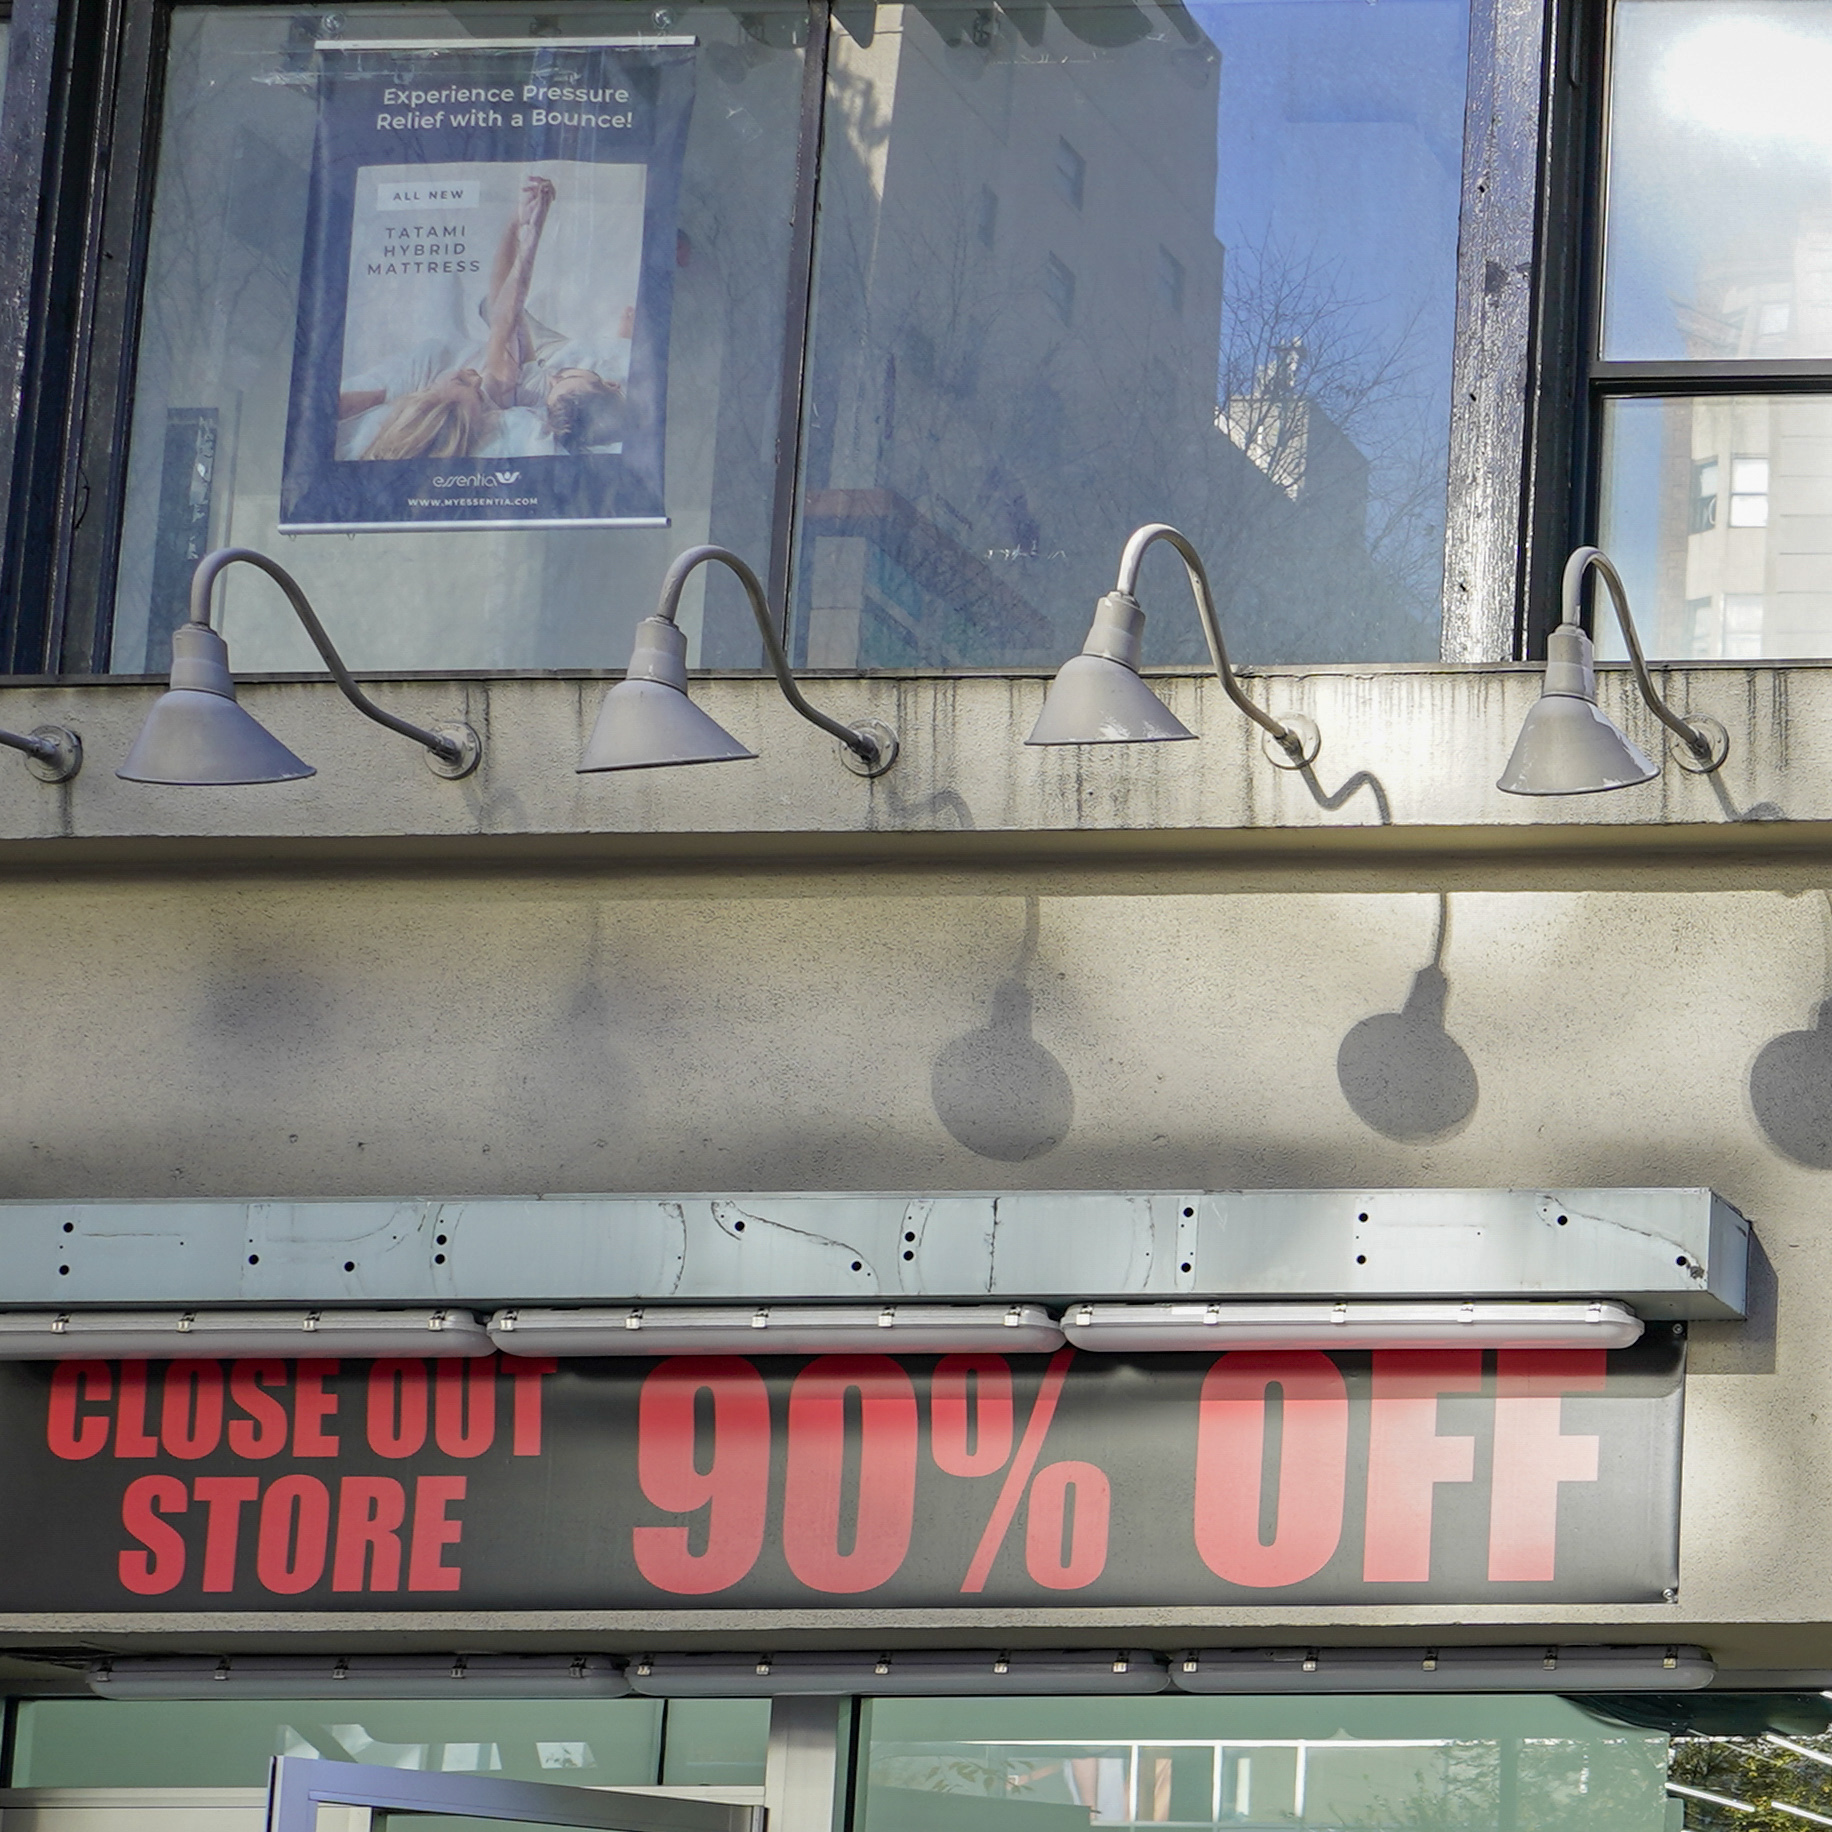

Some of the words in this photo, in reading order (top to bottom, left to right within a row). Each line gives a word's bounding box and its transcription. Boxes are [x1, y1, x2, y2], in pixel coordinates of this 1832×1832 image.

[384, 85, 514, 108] Experience
[523, 86, 629, 103] Pressure
[377, 111, 444, 131] Relief
[450, 110, 502, 128] with
[511, 115, 523, 127] a
[532, 110, 632, 129] Bounce!
[393, 191, 422, 201] ALL
[429, 189, 464, 200] NEW
[386, 225, 466, 239] TATAMI
[384, 242, 466, 257] HYBRID
[367, 260, 481, 275] MATTRESS
[432, 472, 498, 487] essentia
[407, 498, 538, 506] WWW.MYESSENTIA.COM
[46, 1357, 339, 1460] CLOSE
[367, 1356, 557, 1459] OUT
[633, 1352, 1110, 1596] 90%
[1192, 1350, 1607, 1588] OFF
[118, 1475, 467, 1595] STORE
